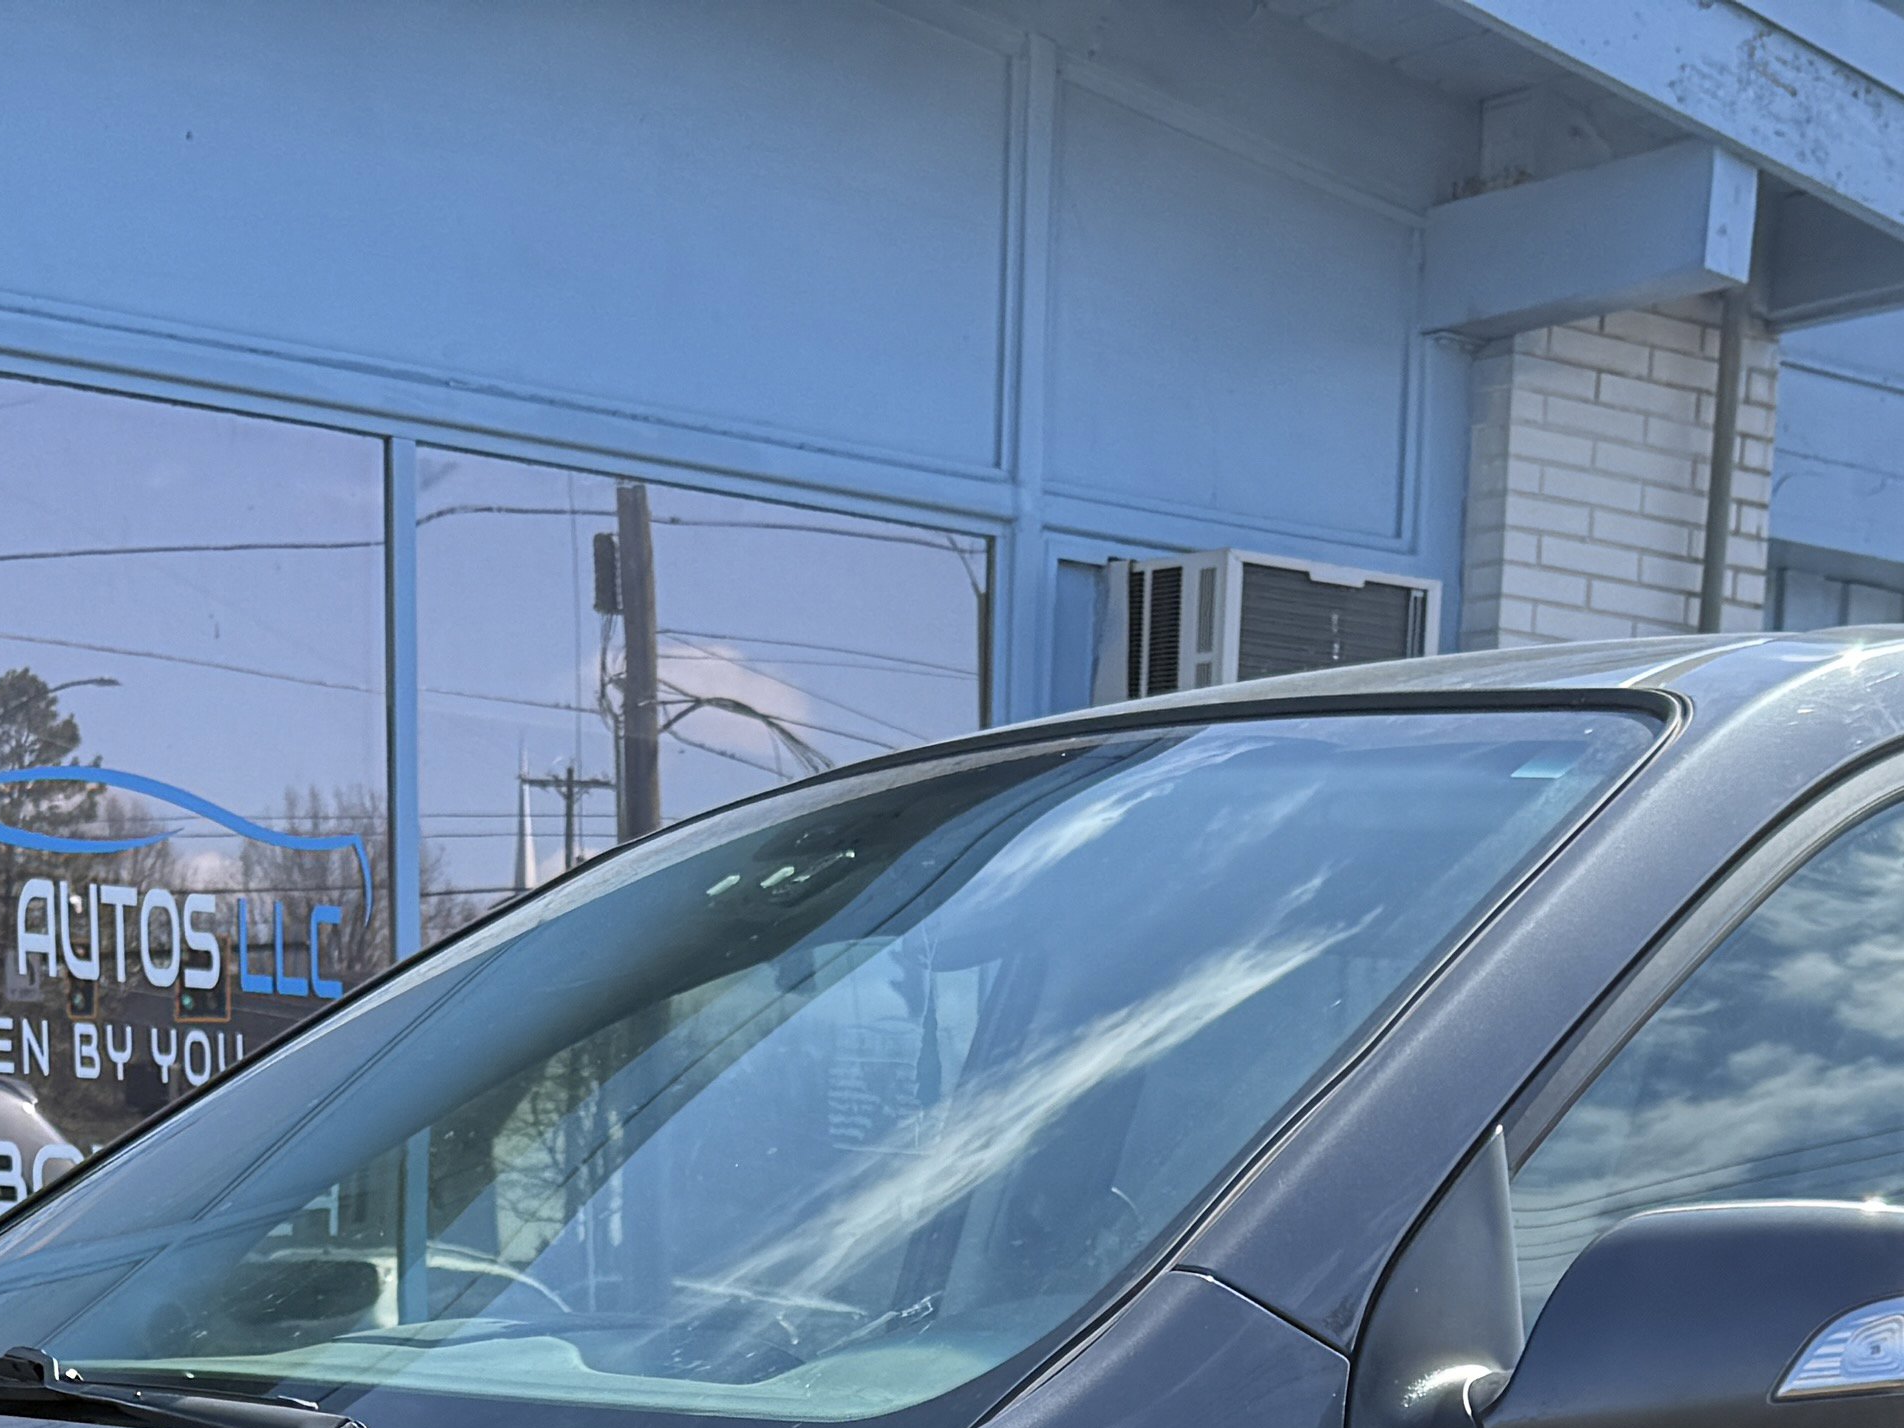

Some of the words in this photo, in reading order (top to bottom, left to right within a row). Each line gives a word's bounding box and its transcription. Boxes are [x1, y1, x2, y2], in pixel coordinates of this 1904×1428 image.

[17, 879, 221, 990] AUTOS
[239, 897, 343, 999] LLC
[75, 1022, 132, 1081] BY
[151, 1027, 243, 1087] YOU
